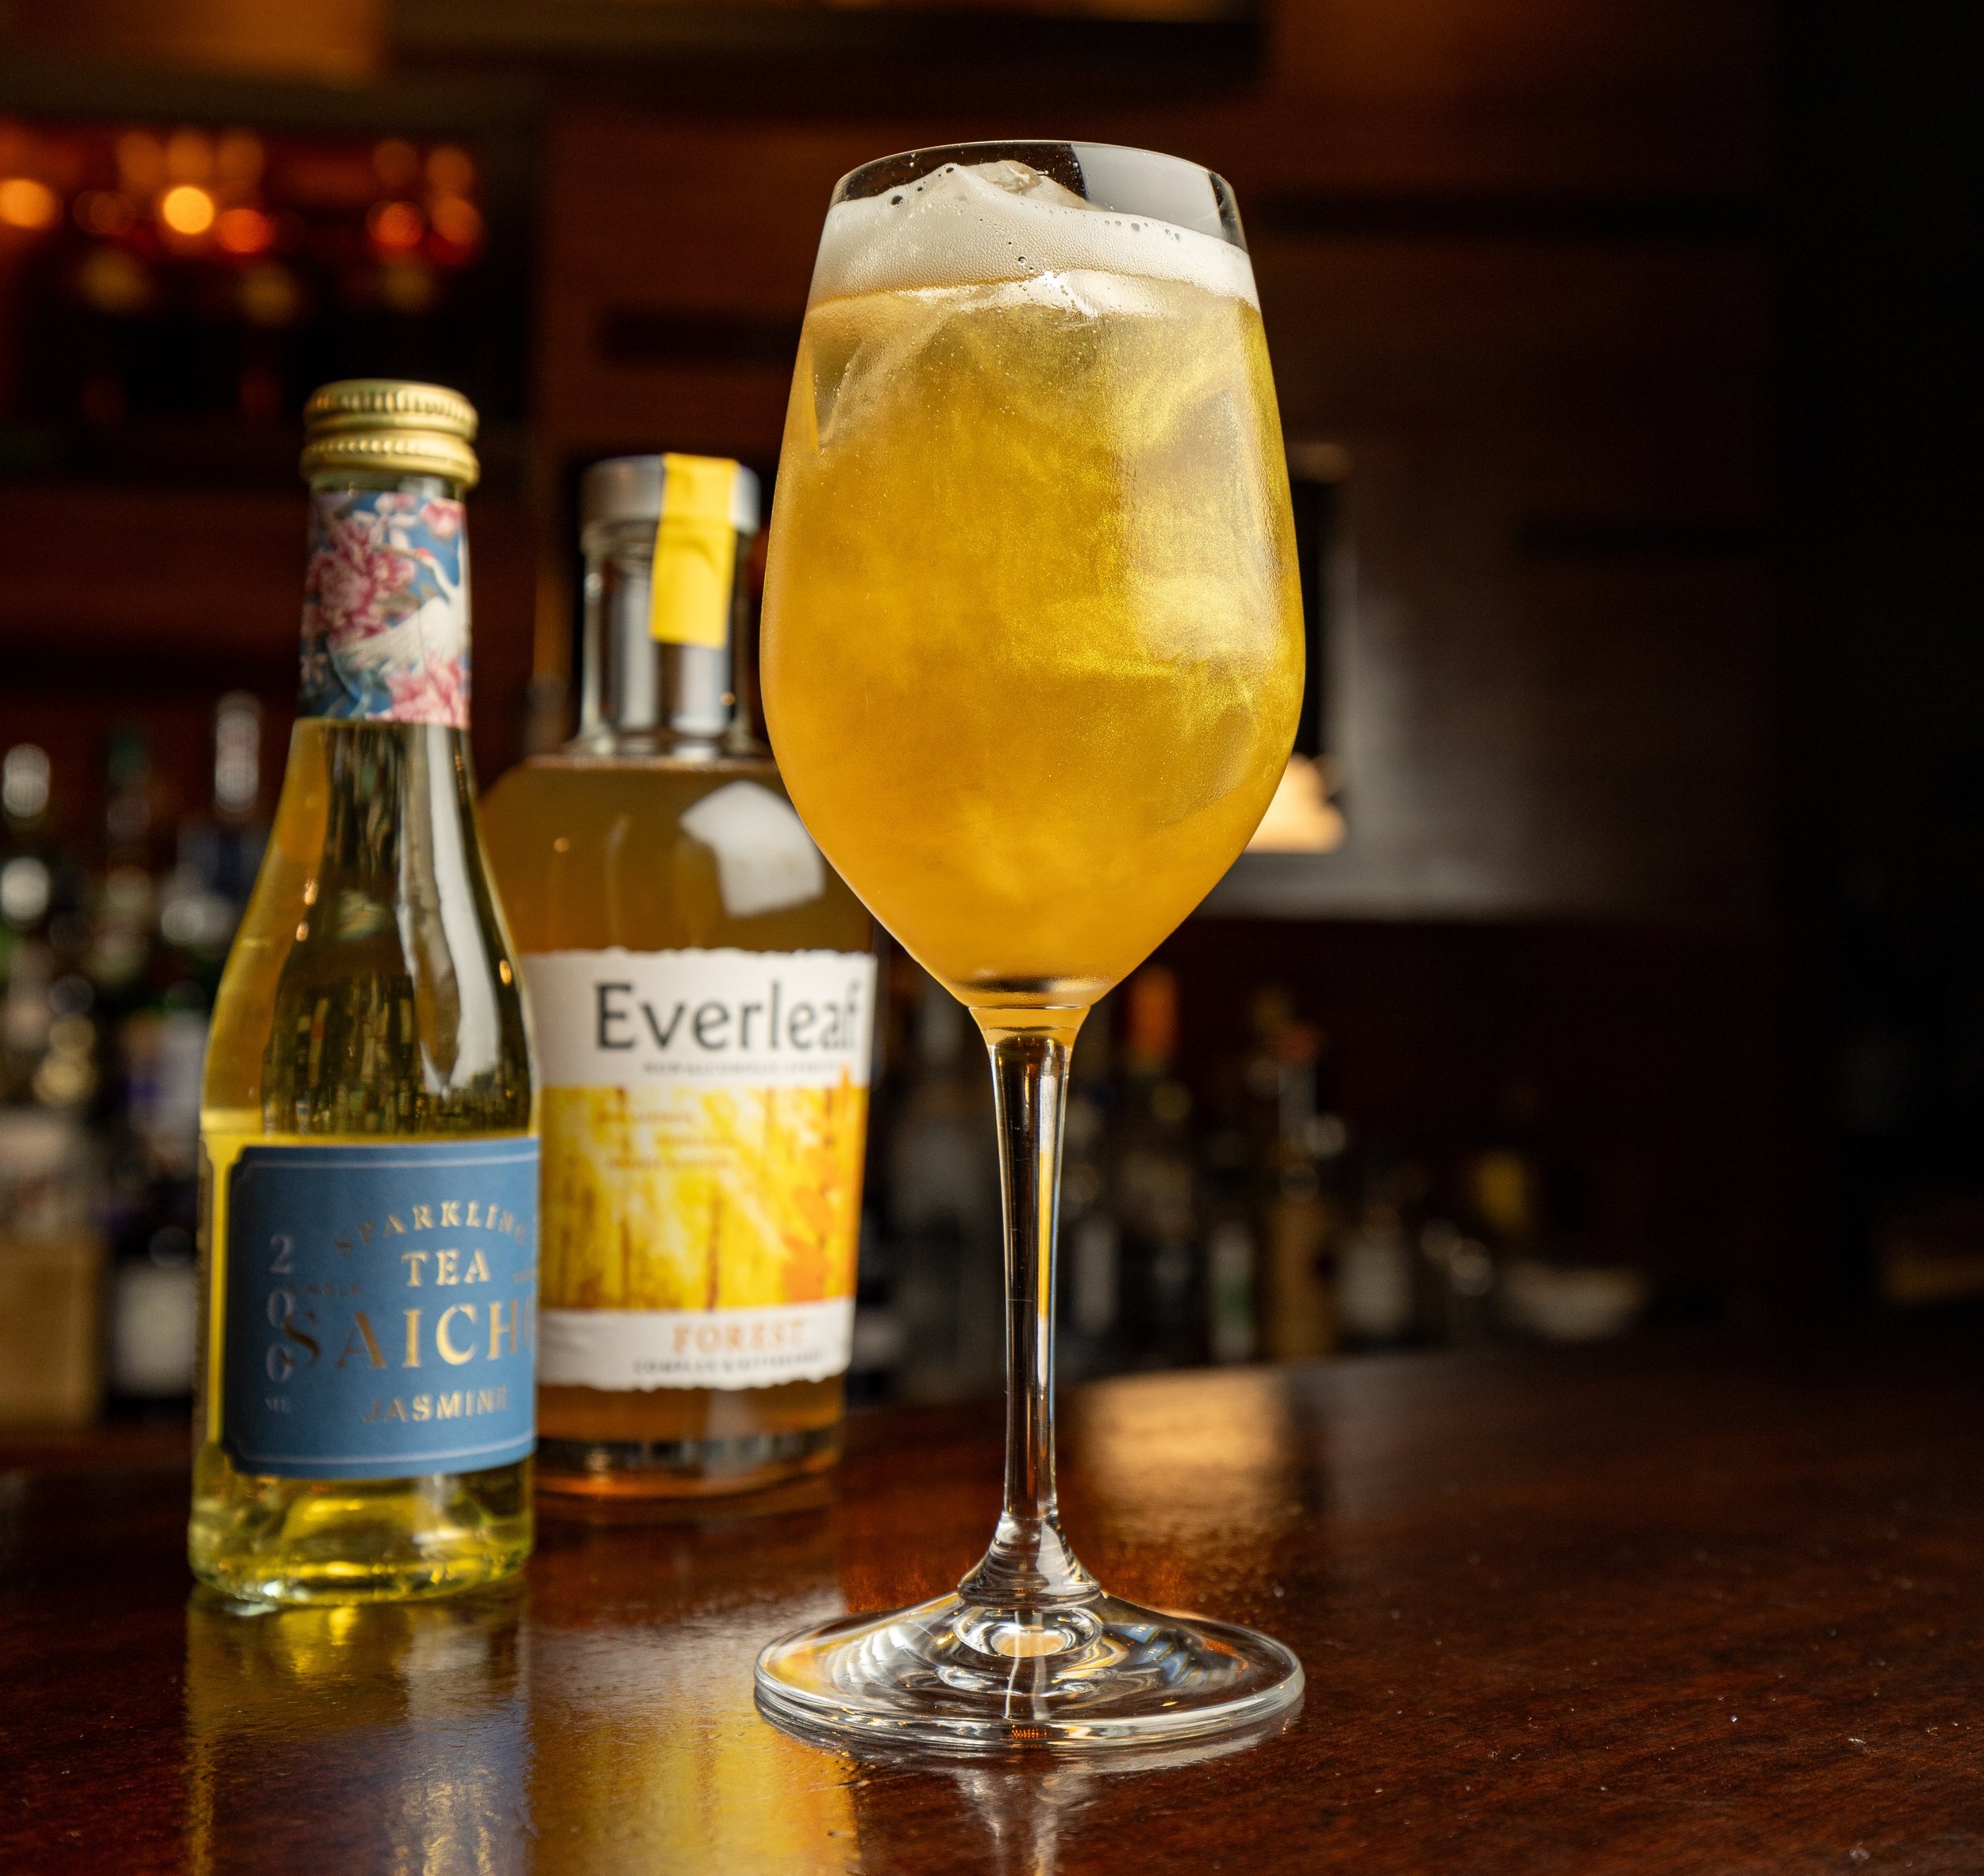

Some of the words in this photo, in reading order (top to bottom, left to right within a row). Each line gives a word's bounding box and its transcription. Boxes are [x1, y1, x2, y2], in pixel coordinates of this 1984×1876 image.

[595, 980, 860, 1051] Everleaf
[402, 1248, 490, 1287] TEA
[282, 1298, 536, 1369] SAICH
